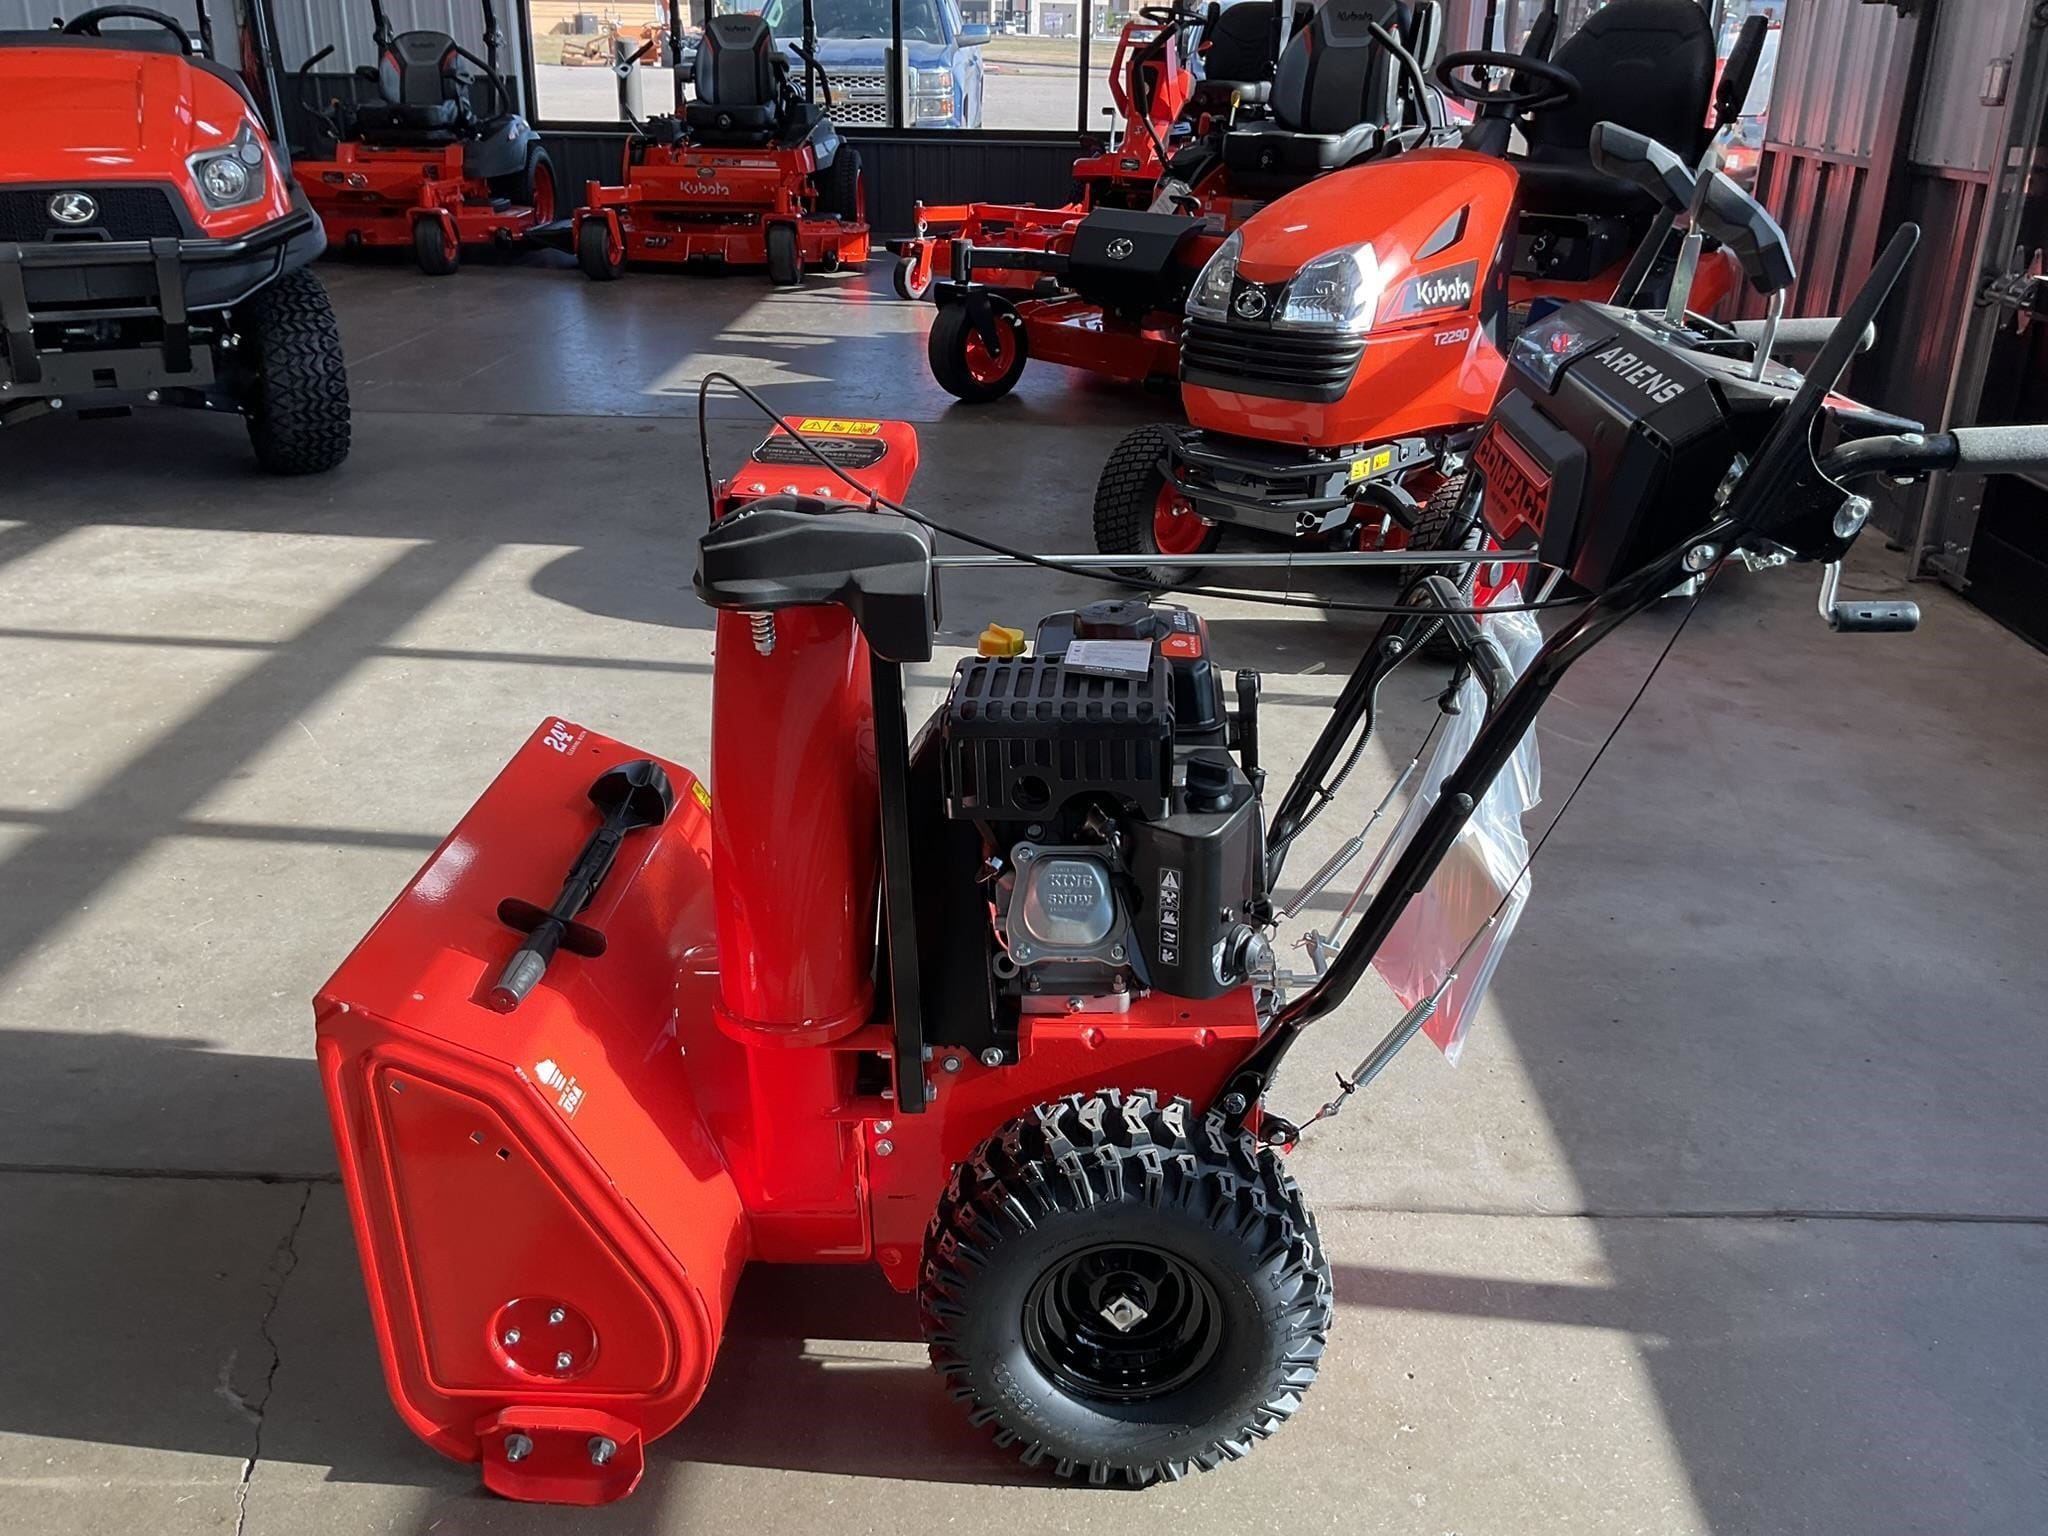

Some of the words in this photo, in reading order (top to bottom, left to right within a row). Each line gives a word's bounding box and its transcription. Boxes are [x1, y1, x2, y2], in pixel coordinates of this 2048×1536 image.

[680, 181, 730, 195] Kubota
[1416, 276, 1470, 305] Kubota
[1433, 328, 1470, 346] T2290
[1594, 346, 1685, 404] ARIENS
[1478, 440, 1549, 531] COMPACT
[1049, 873, 1093, 888] KING
[1047, 893, 1094, 905] SNOW
[562, 1085, 583, 1113] USA
